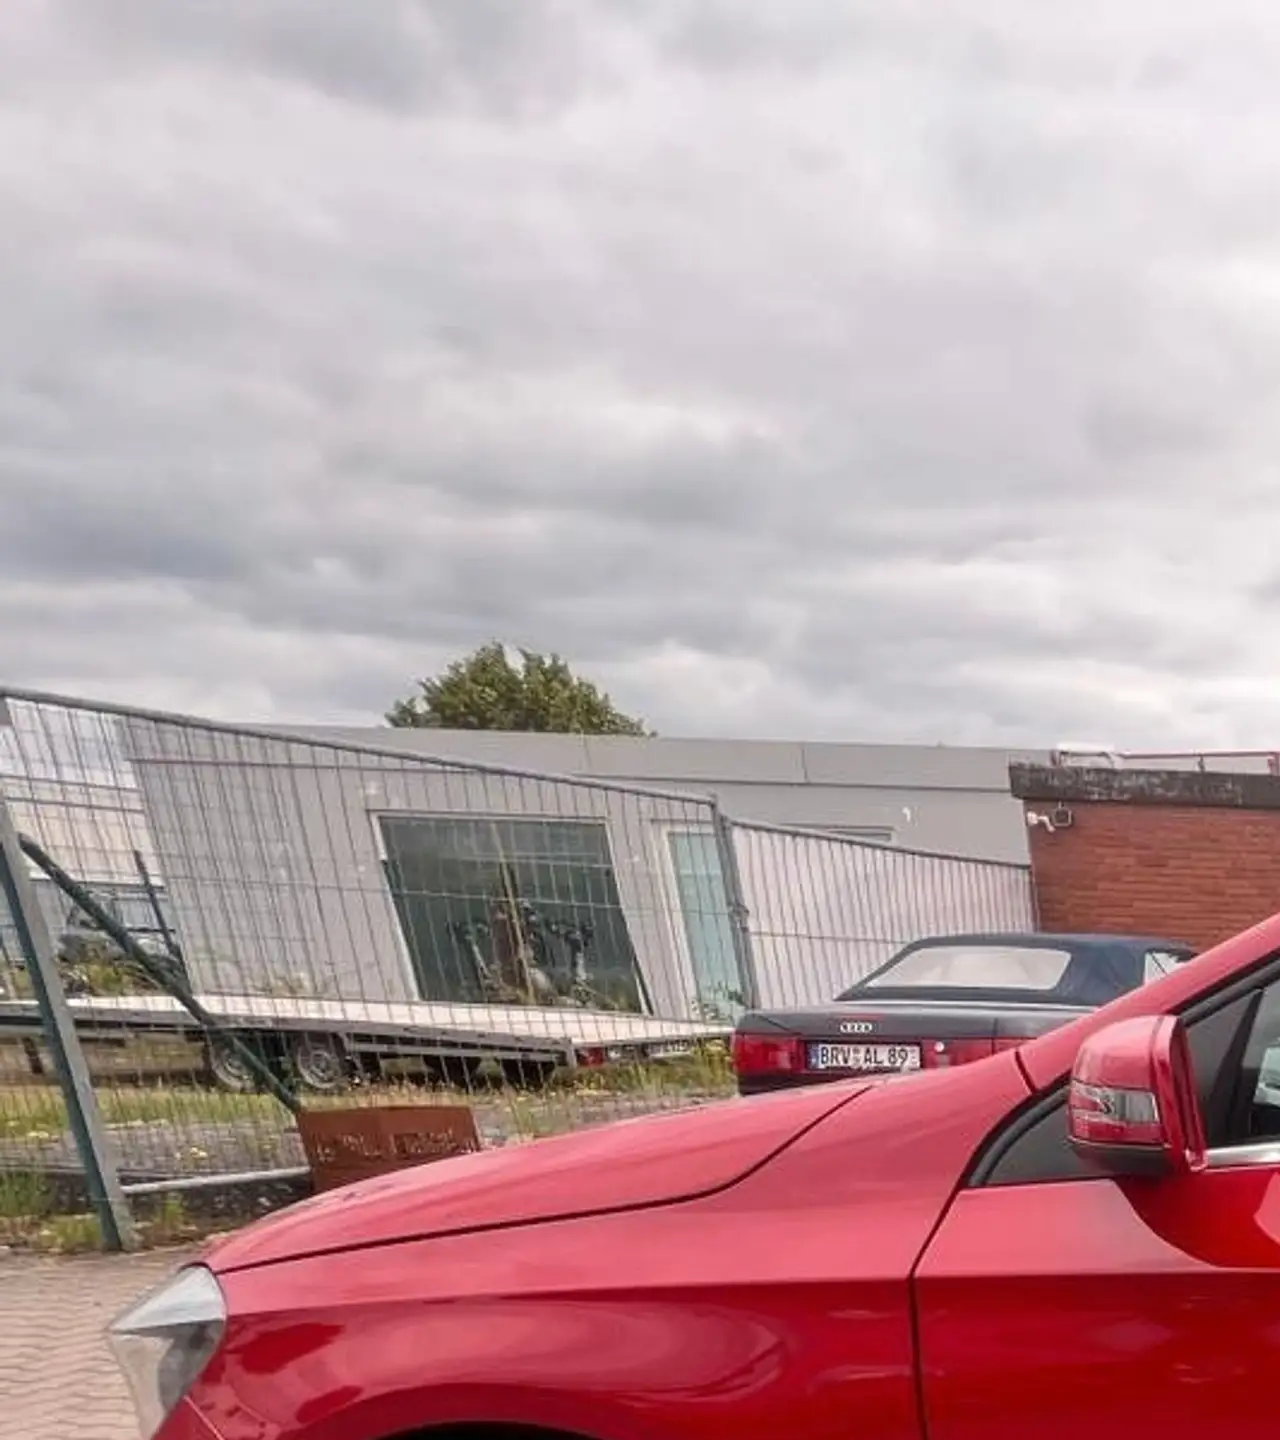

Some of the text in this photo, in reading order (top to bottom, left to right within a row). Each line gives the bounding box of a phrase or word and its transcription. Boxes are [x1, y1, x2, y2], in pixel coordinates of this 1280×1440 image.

[820, 1046, 909, 1065] BRV AL 89
